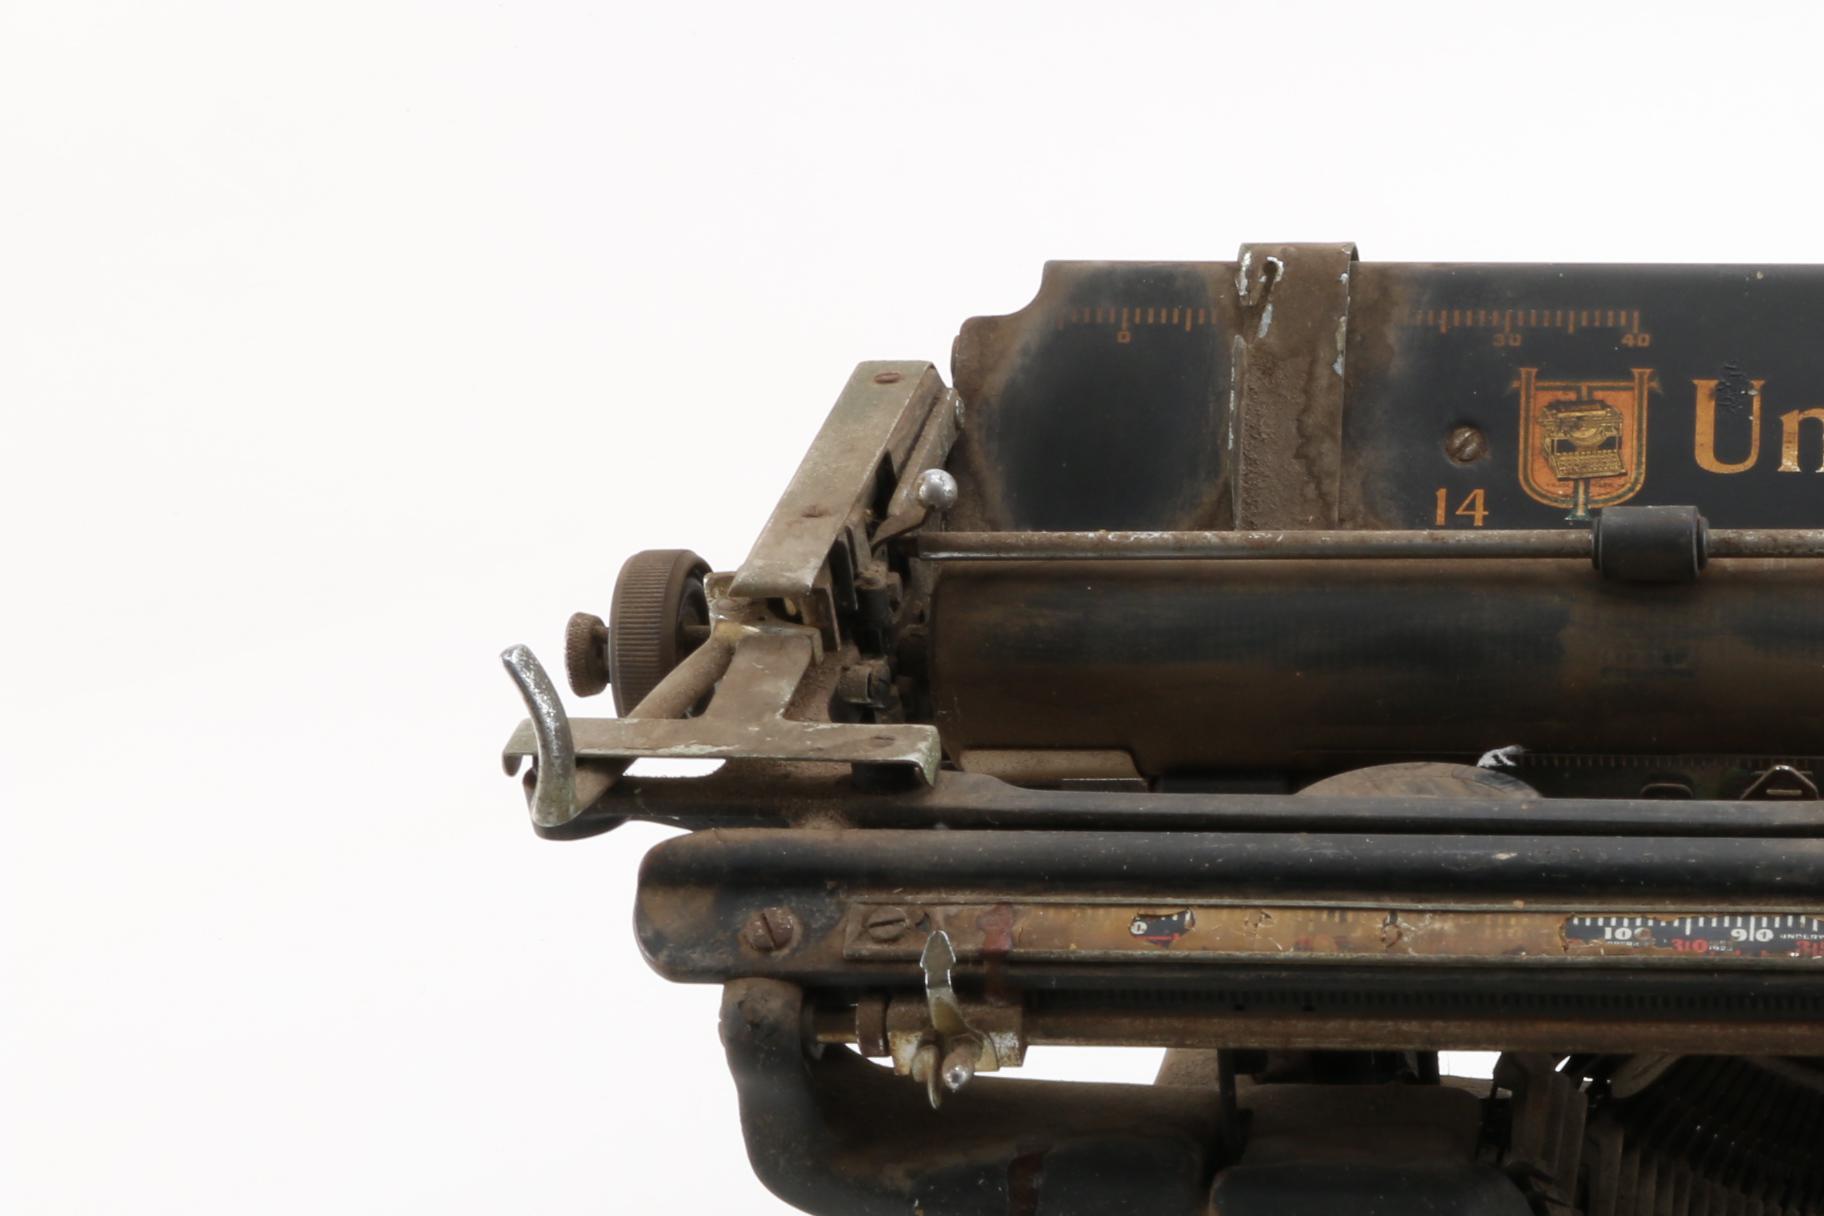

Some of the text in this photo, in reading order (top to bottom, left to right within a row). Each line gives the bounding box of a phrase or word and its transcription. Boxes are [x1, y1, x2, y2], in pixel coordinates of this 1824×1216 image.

[1621, 333, 1650, 347] 40
[1435, 488, 1489, 526] 14
[1731, 928, 1774, 942] 90
